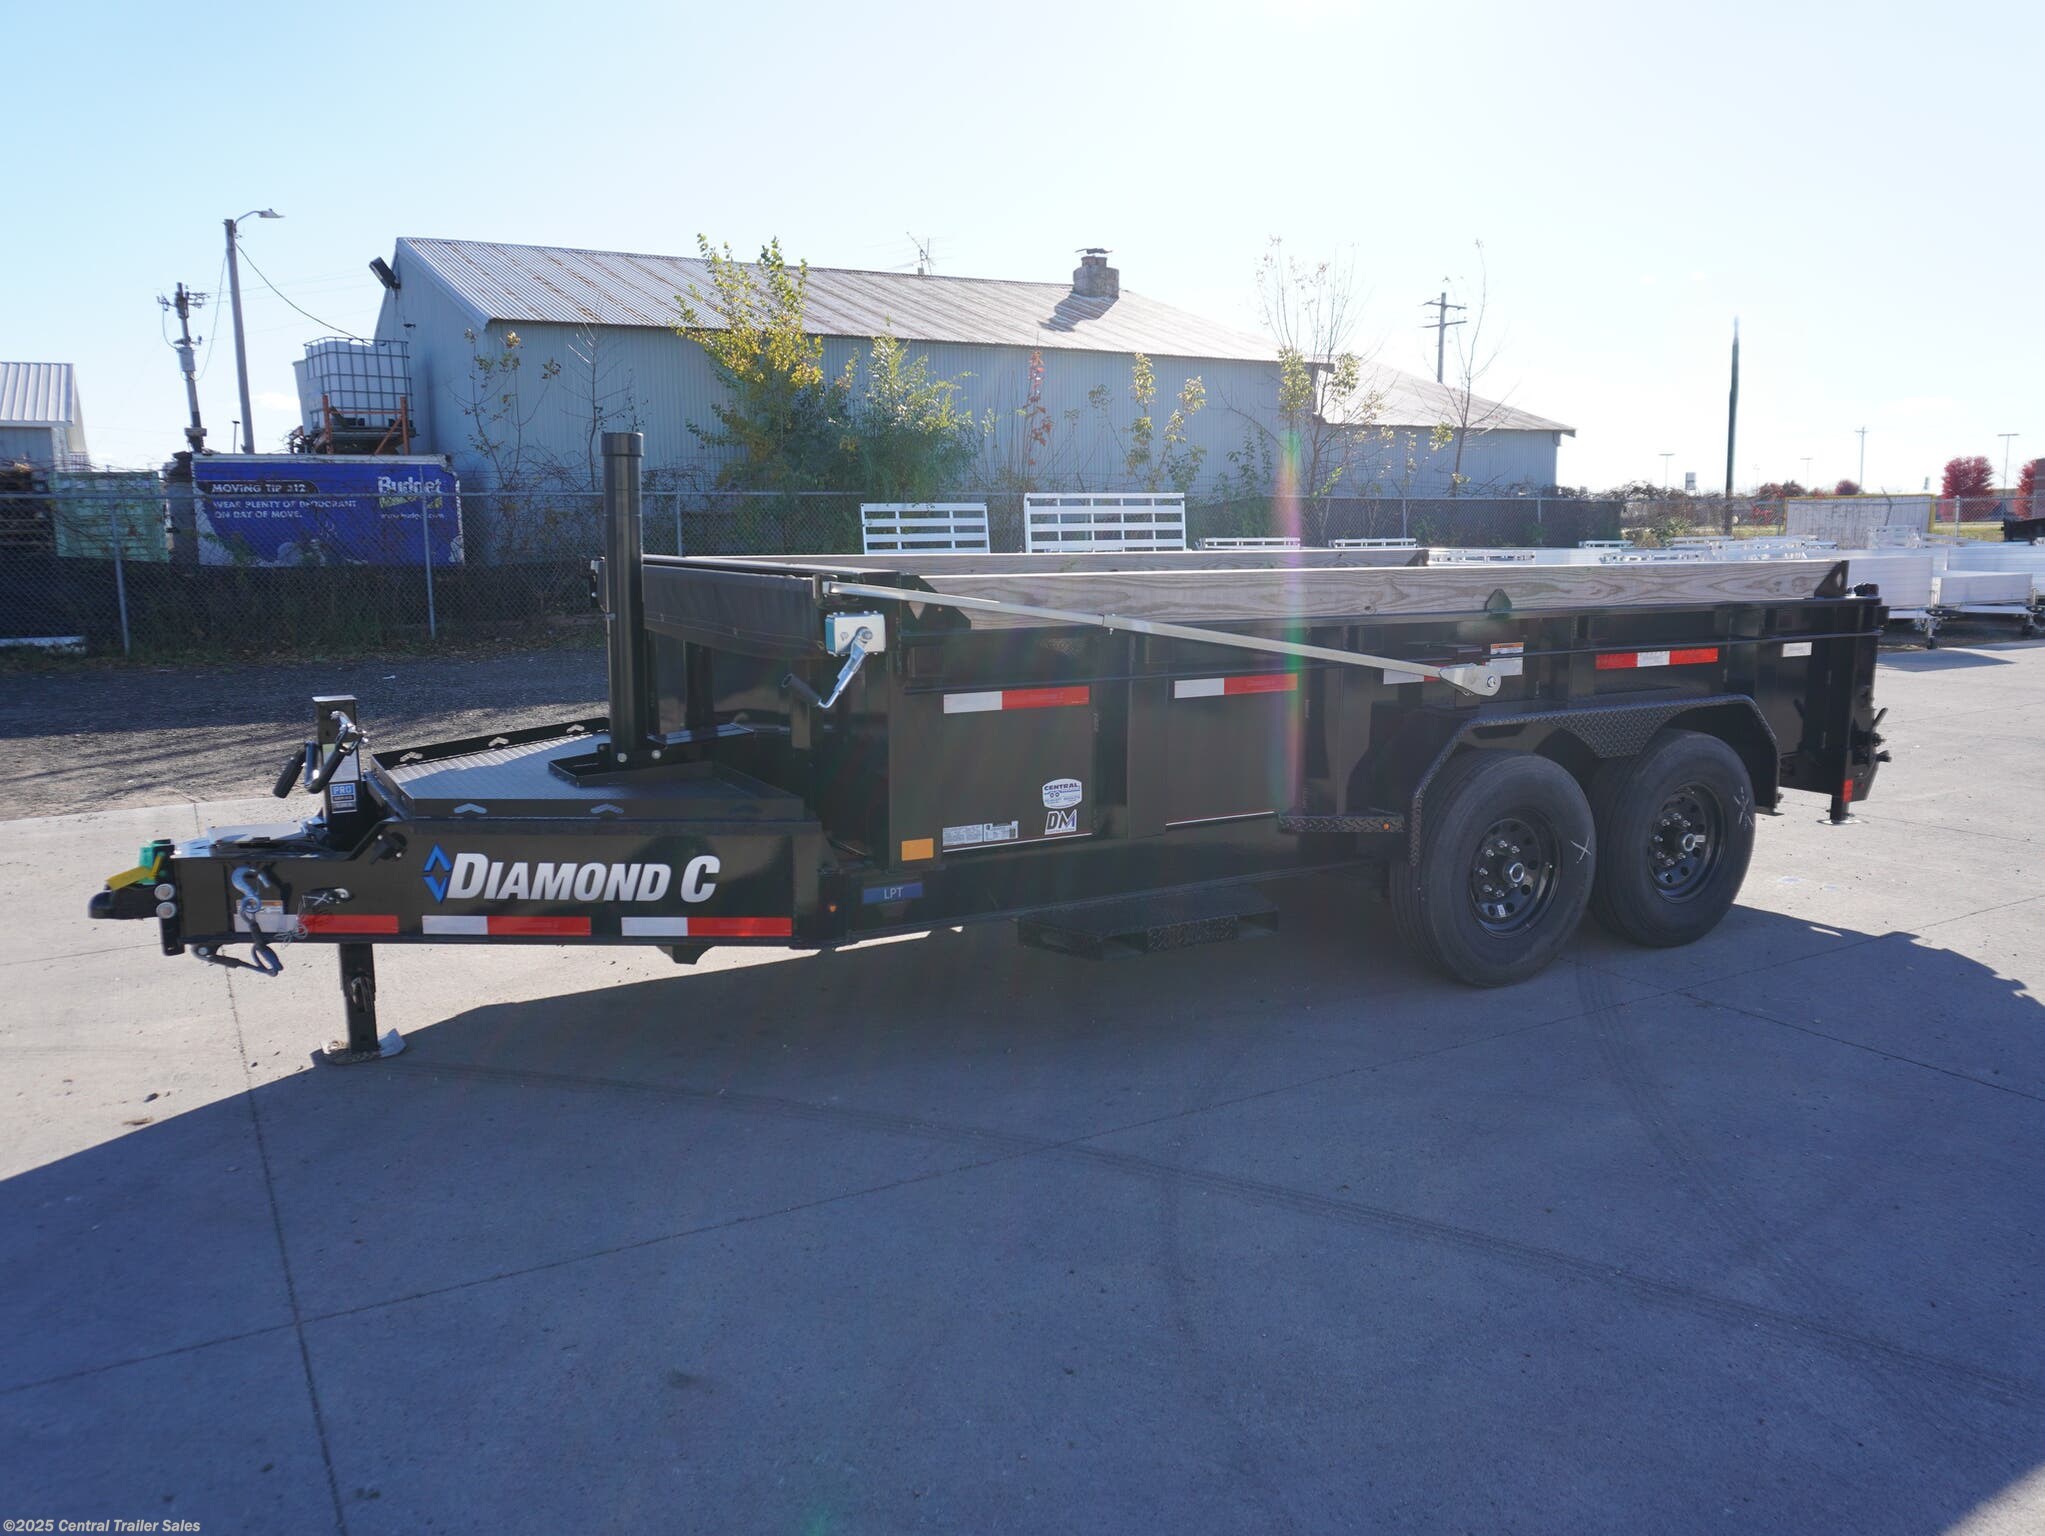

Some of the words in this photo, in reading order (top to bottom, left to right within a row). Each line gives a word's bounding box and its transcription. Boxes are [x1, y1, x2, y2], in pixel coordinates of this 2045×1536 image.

[1044, 782, 1078, 791] CENTRAL
[681, 855, 721, 903] C
[883, 887, 904, 900] LPT
